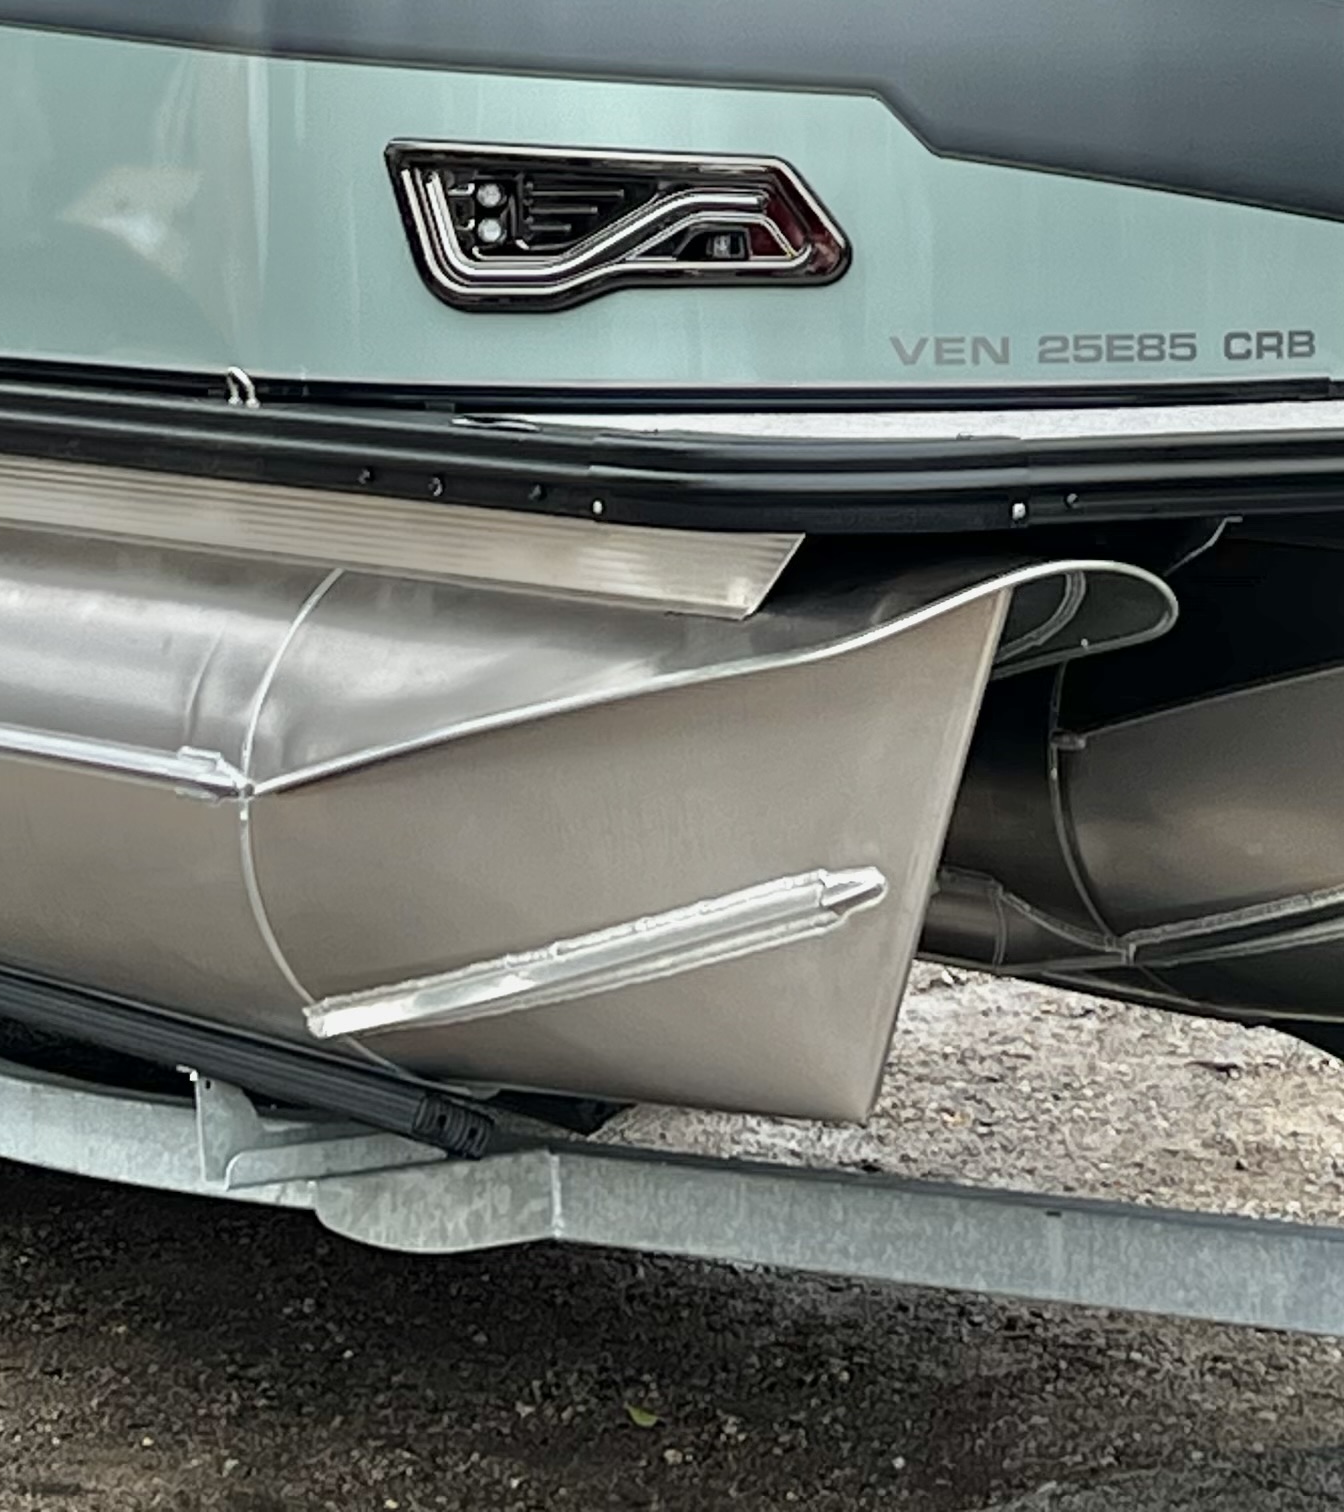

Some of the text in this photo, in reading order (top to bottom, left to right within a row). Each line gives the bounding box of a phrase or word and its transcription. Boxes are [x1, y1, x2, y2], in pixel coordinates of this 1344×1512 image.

[889, 330, 1316, 366] VEN 25E85 CRB
